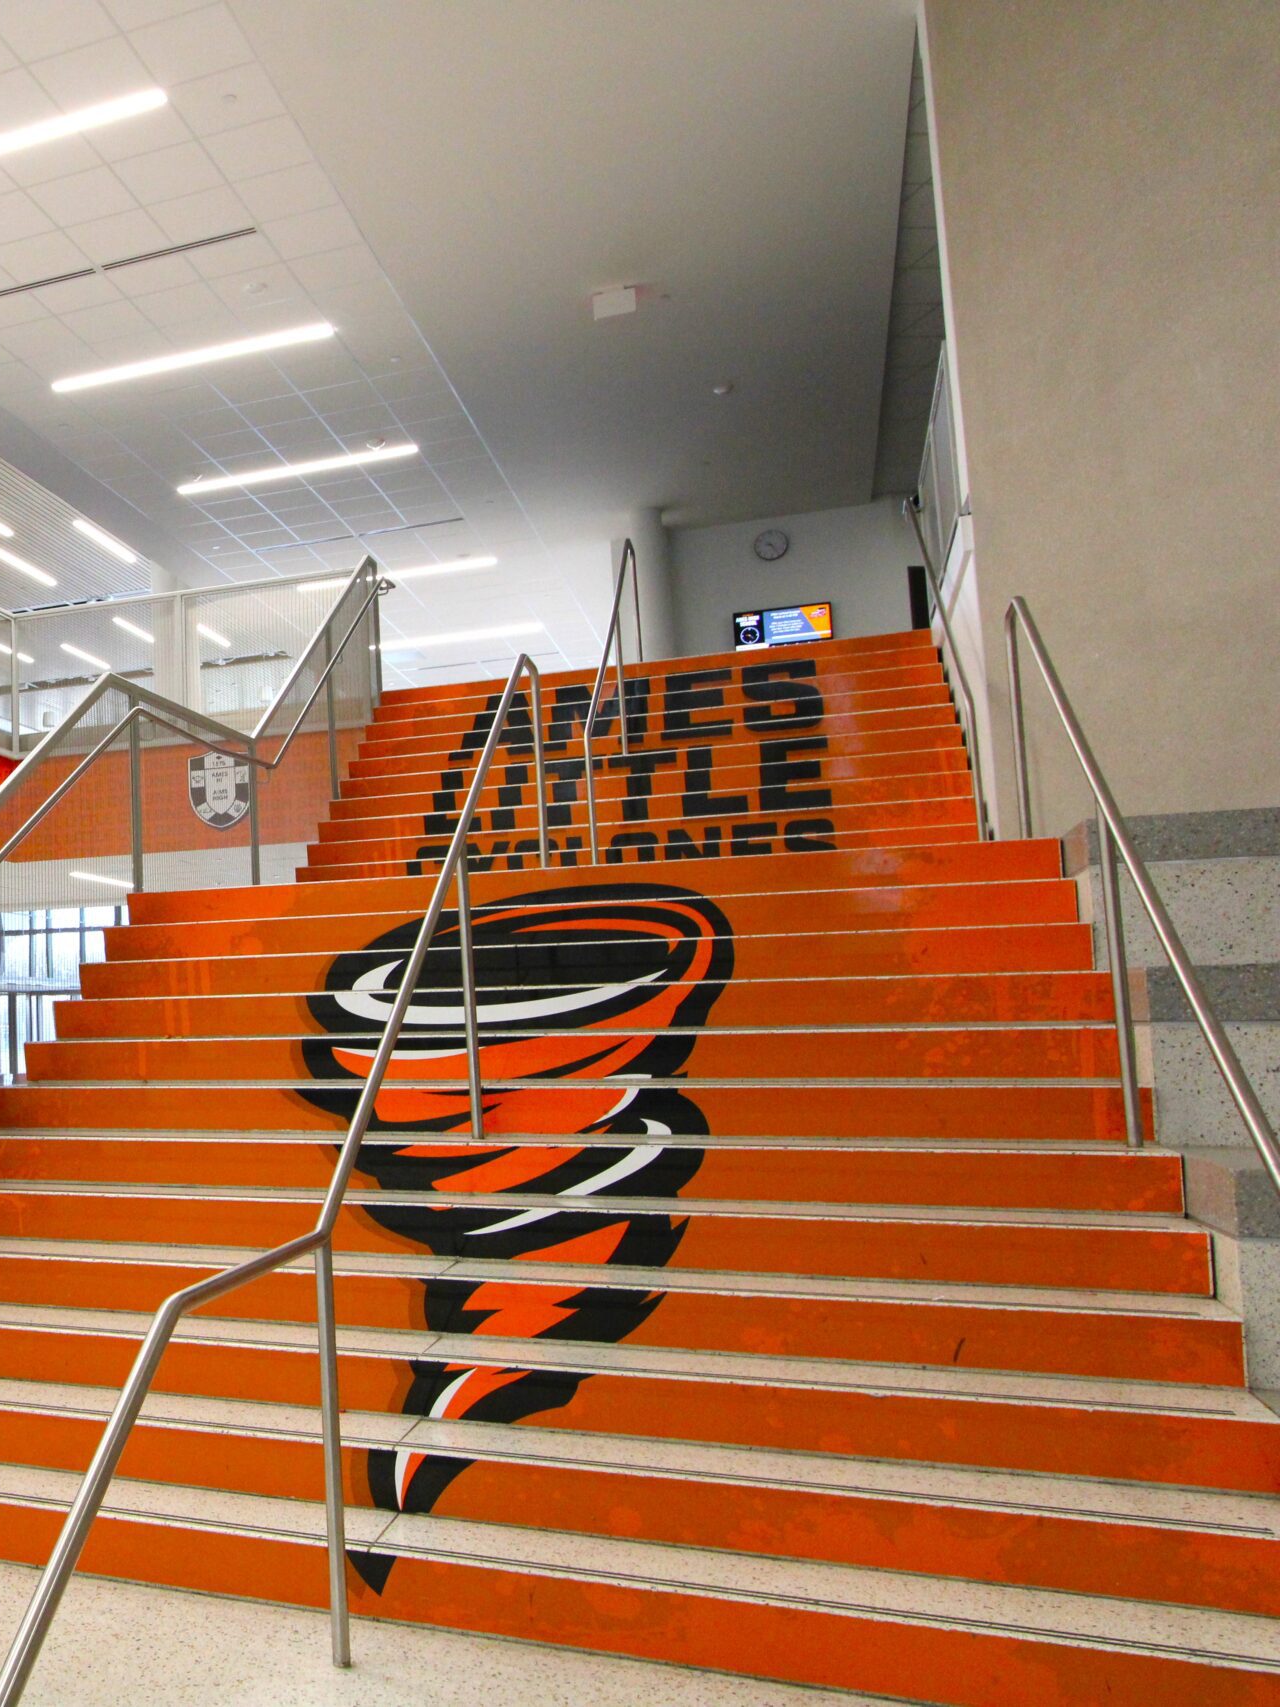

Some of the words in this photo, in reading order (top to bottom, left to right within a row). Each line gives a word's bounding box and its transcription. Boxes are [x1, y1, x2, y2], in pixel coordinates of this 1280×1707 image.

[448, 659, 824, 761] AMES
[424, 736, 832, 836] LITTLE
[406, 818, 837, 876] CYCLONES
